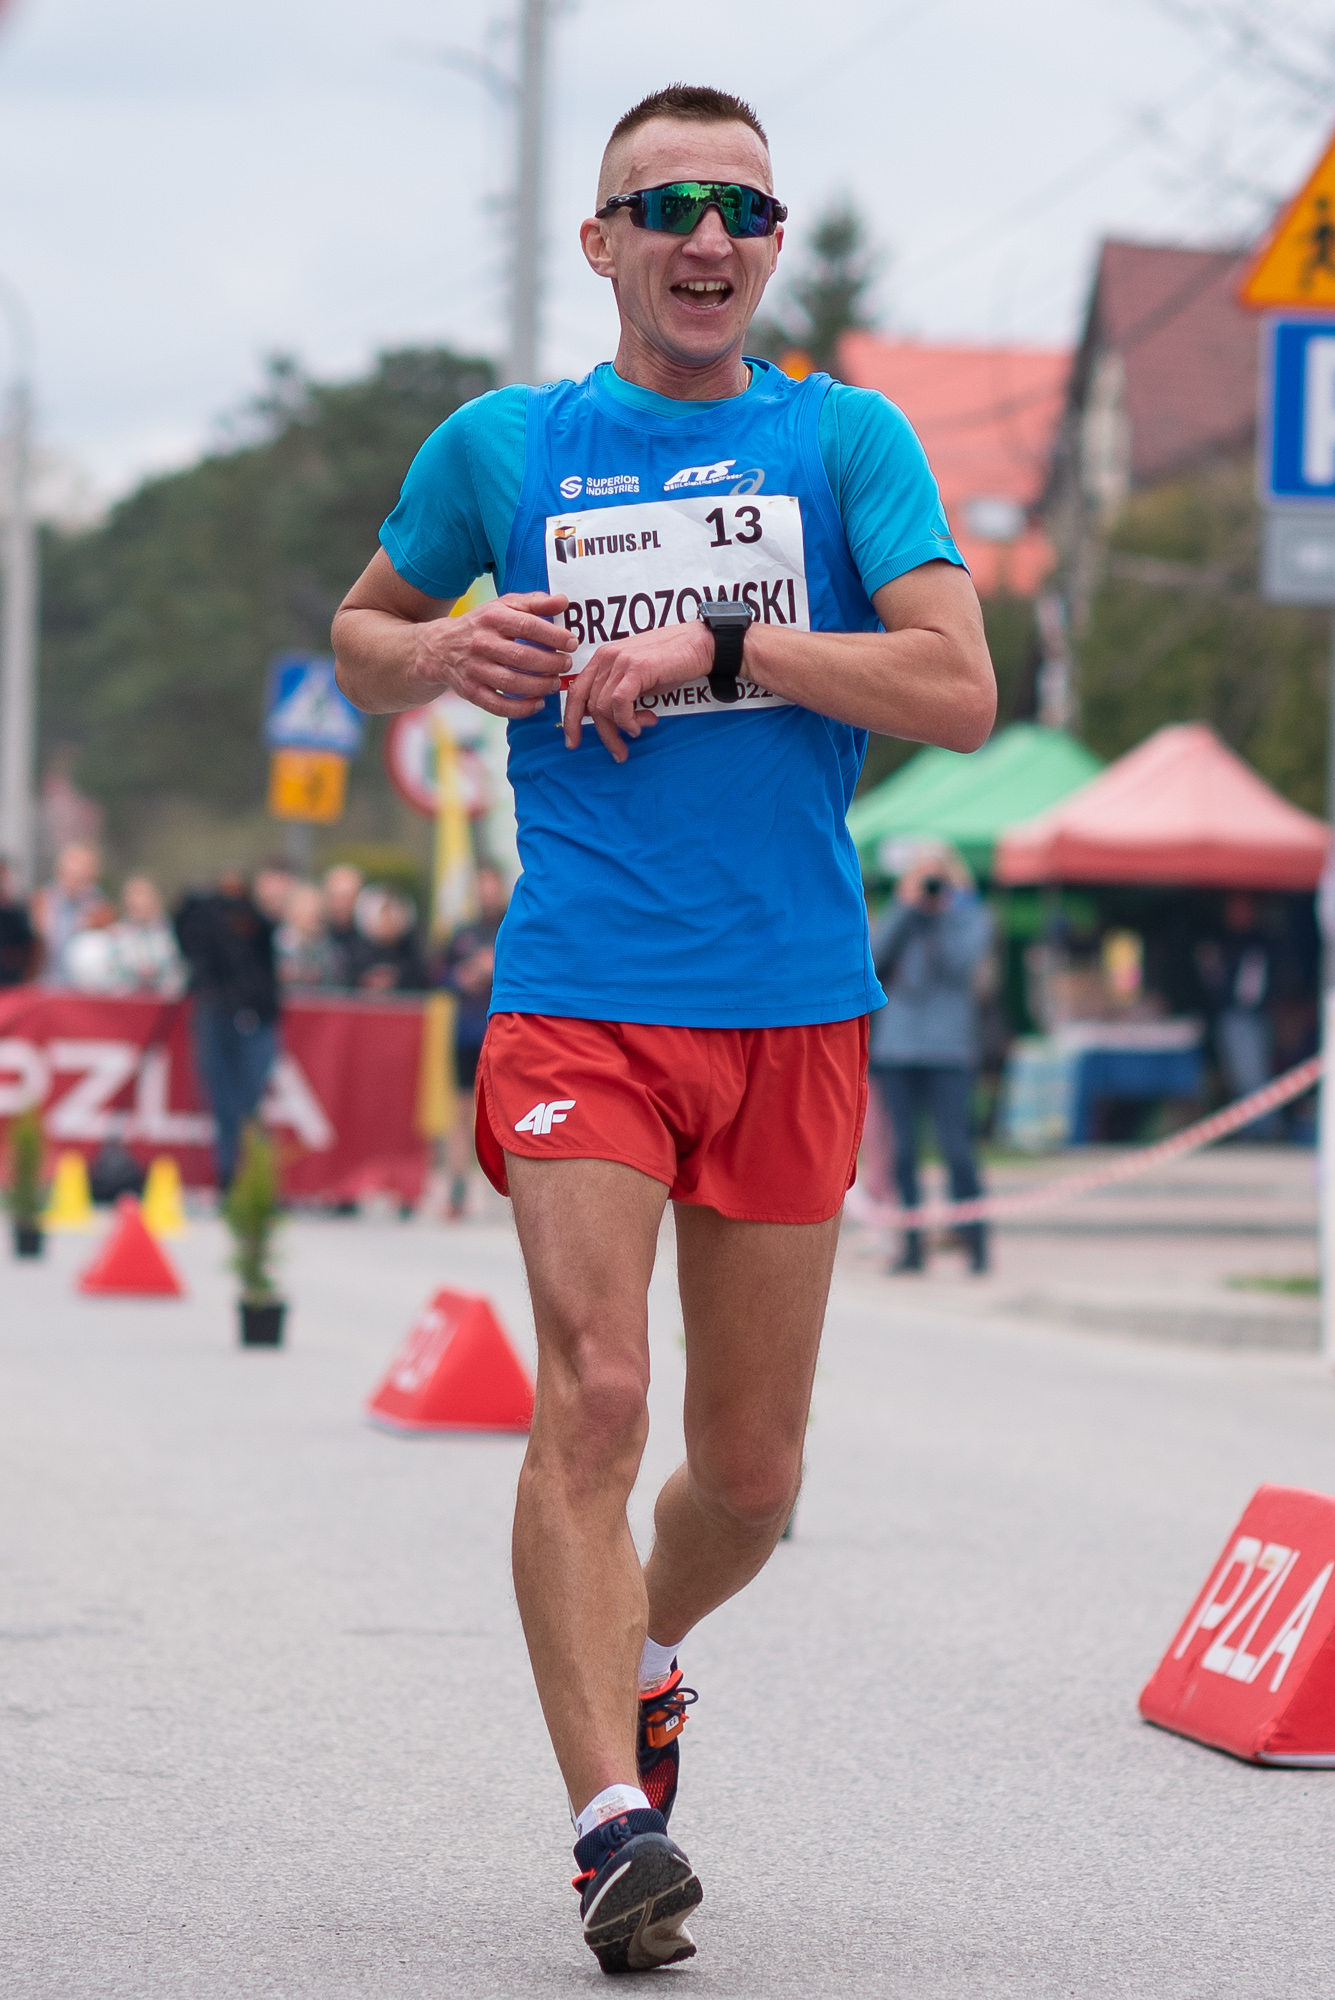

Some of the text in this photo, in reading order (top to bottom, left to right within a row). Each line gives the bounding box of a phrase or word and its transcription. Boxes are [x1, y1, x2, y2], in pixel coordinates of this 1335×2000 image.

[586, 475, 640, 488] SUPERIOR
[586, 484, 640, 496] INDUSTRIES
[705, 505, 763, 548] 13
[577, 530, 661, 558] INTUIS.PL
[514, 1099, 577, 1136] 4F
[1173, 1535, 1335, 1694] PZLA
